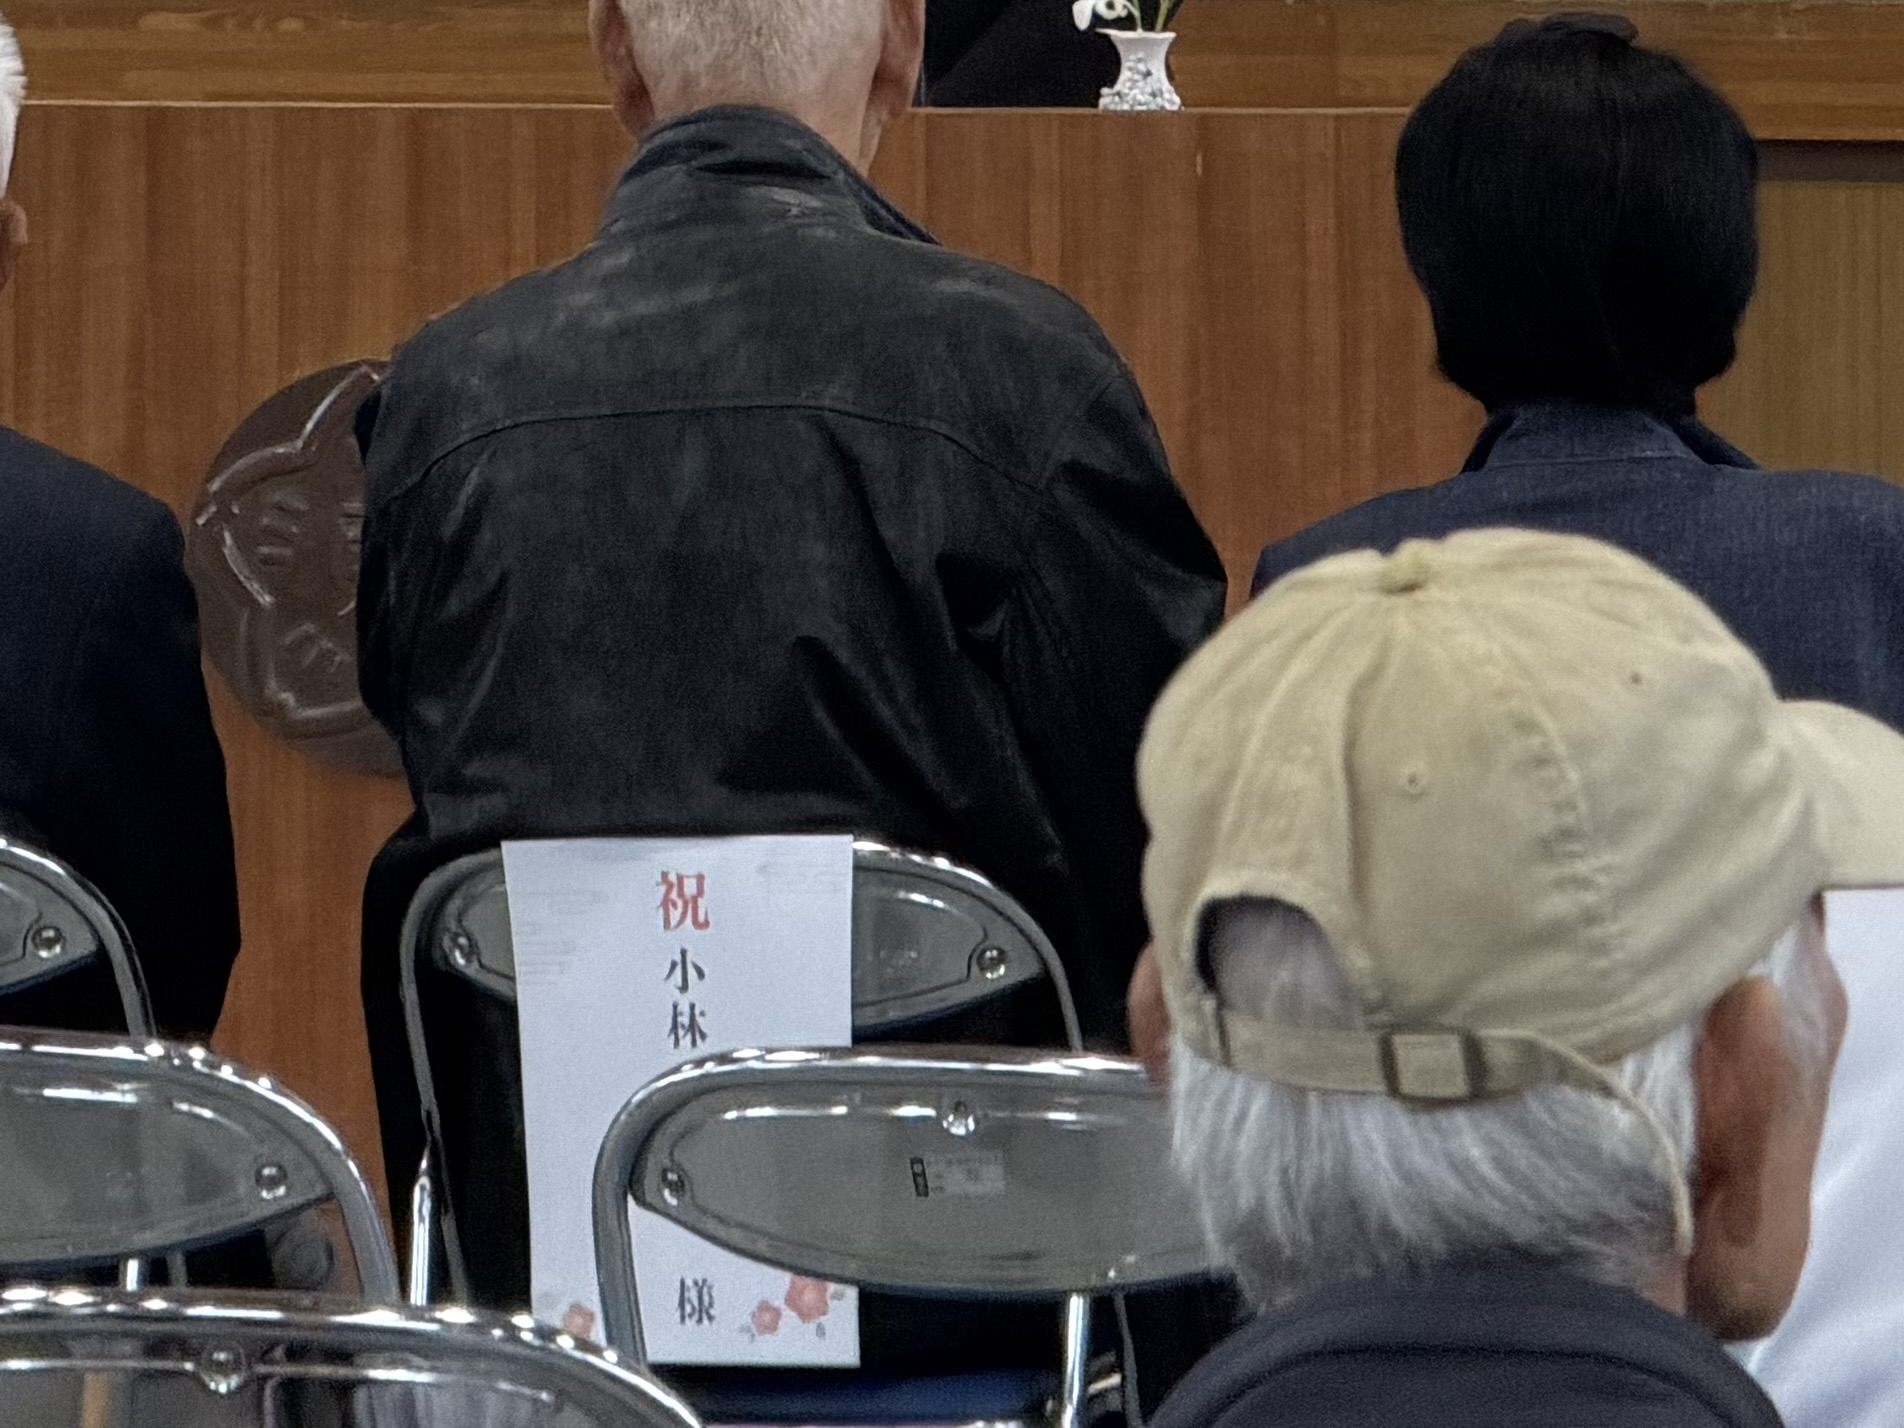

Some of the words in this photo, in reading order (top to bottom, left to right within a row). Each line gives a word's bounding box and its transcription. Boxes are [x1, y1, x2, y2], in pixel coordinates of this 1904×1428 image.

[655, 869, 711, 932] 祝
[663, 946, 708, 1049] 小林
[677, 1276, 716, 1325] 様
